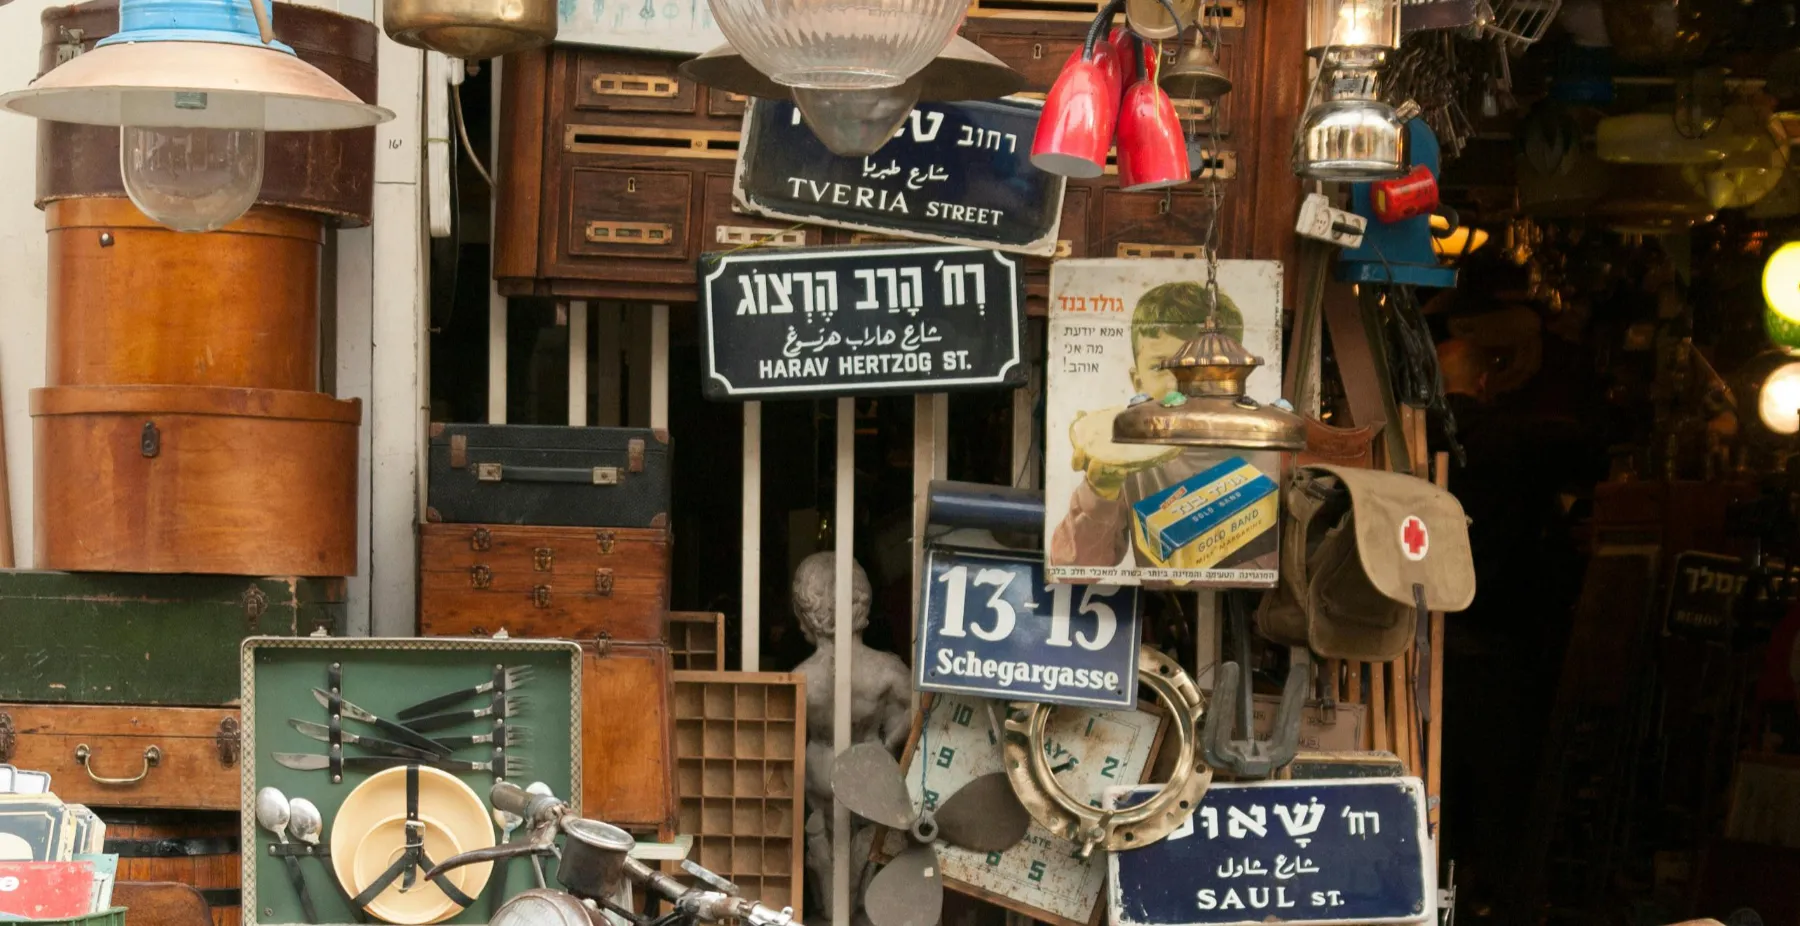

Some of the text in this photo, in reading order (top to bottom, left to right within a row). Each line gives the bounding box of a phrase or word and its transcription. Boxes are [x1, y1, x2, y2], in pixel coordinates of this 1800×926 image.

[957, 124, 1018, 154] רחוב
[862, 155, 950, 190] شارع طبريا
[787, 176, 1004, 226] TVERIA STREET
[1058, 293, 1124, 313] גולד בנד
[845, 324, 897, 351] هاراب
[900, 321, 942, 351] شارع
[1063, 326, 1124, 337] אמא יודעת
[1064, 344, 1104, 355] מה אני
[759, 350, 972, 380] HARAV HERTZOG ST.
[1063, 356, 1100, 373] אוהב!
[1192, 491, 1242, 522] GOLD BAND
[1198, 509, 1259, 552] GOLD BAND
[936, 647, 1120, 691] Schegargasse
[952, 703, 974, 727] 10
[937, 746, 955, 769] 9
[1101, 756, 1120, 779] 2
[1028, 860, 1047, 882] 5
[1217, 854, 1320, 880] شارع شاول
[1197, 886, 1346, 911] SAUL ST.
